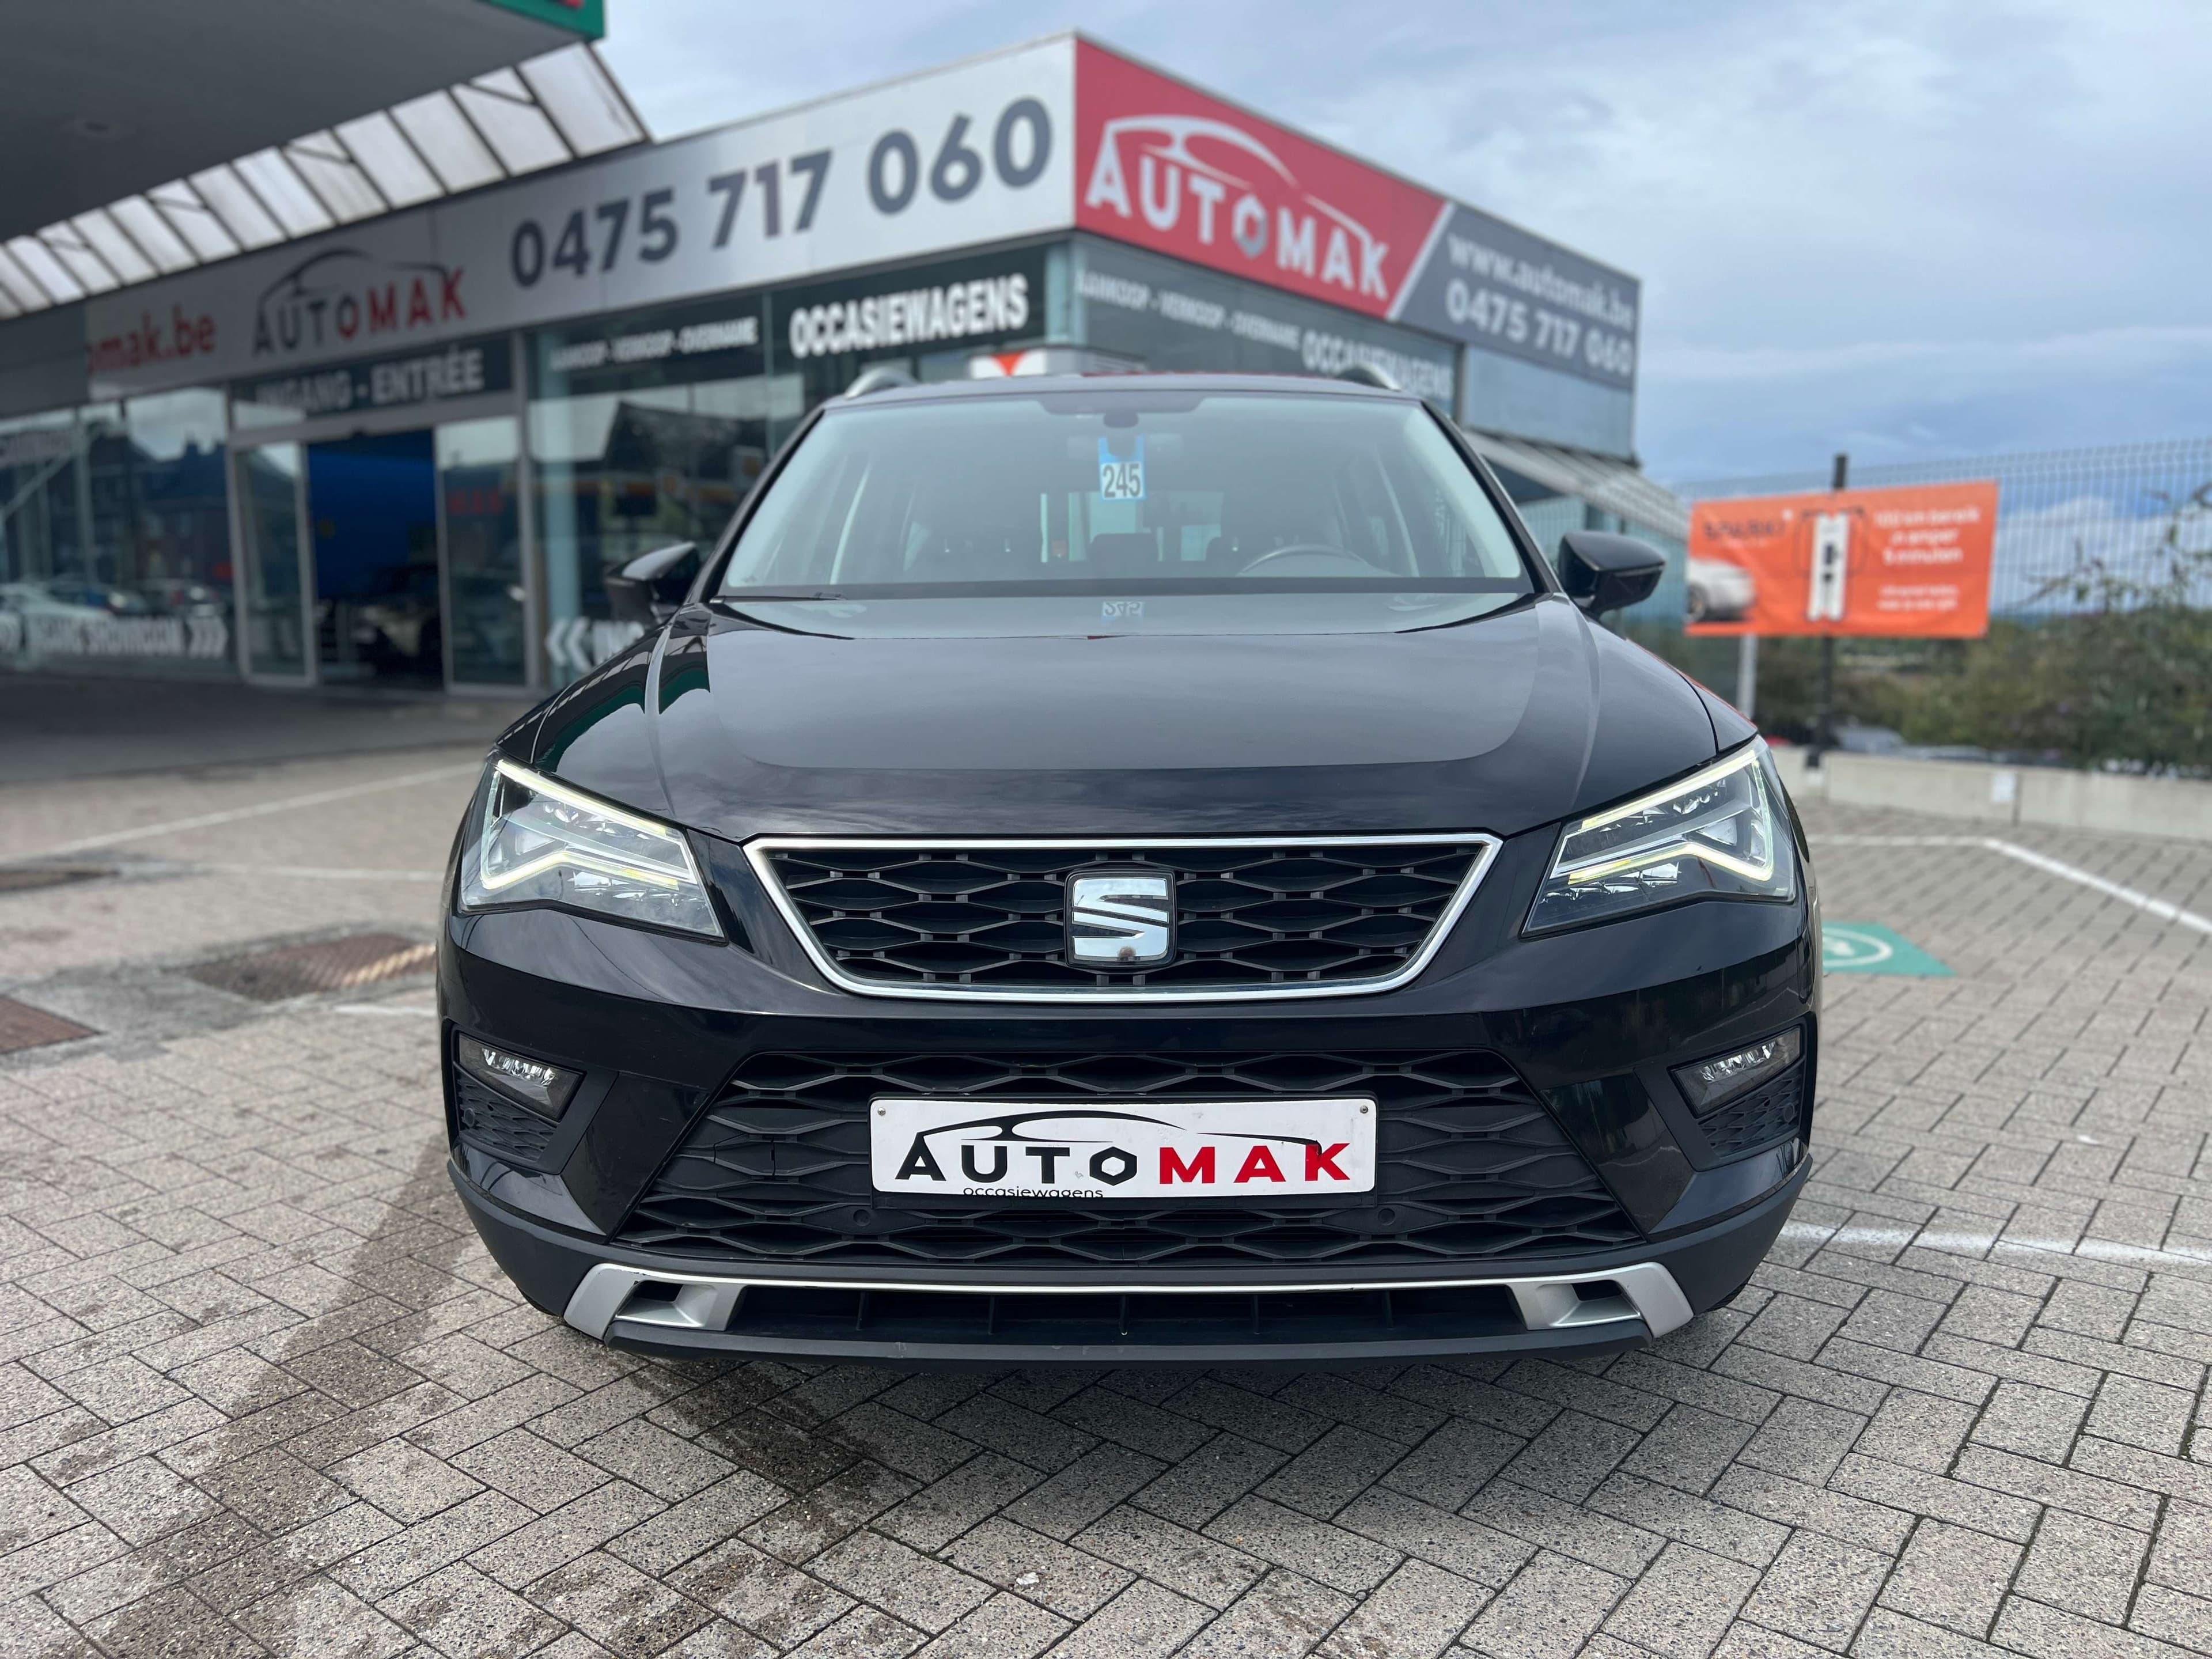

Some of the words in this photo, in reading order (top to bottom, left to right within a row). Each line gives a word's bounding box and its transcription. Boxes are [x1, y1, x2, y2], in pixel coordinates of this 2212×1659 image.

[511, 185, 679, 289] 0475
[708, 147, 833, 251] 717
[866, 96, 1053, 217] 060
[1084, 124, 1390, 301] AUTOMAK
[252, 268, 467, 357] AUTOMAK
[790, 272, 1029, 359] OCCASIEWAGENS
[1447, 230, 1634, 332] www.automak.be
[1445, 278, 1528, 344] 0475
[1535, 307, 1581, 359] 717
[1585, 327, 1634, 376] 060
[370, 346, 484, 404] ENTRÉE
[1103, 463, 1141, 498] 245
[895, 1134, 1350, 1187] AUTOMAK
[963, 1185, 1103, 1198] occasiewagens
